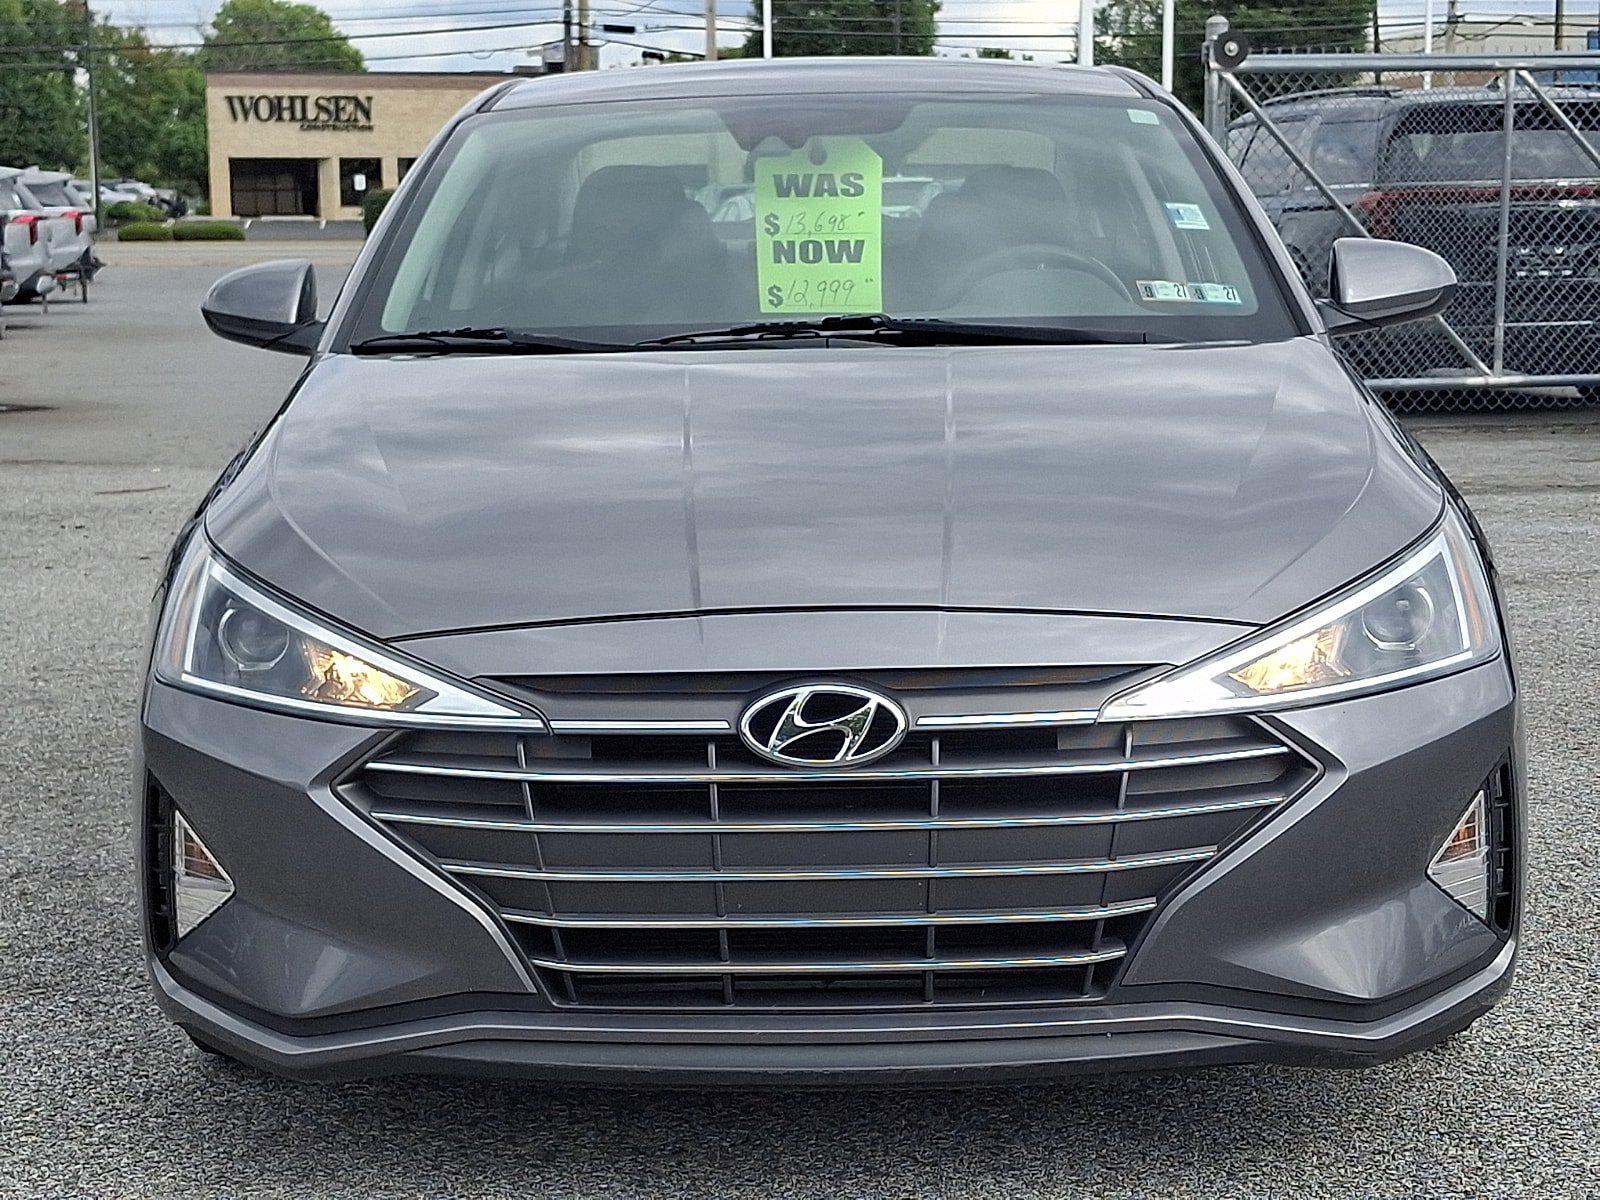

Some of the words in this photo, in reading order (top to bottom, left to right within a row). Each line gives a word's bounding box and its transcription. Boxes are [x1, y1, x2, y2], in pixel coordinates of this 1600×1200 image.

[225, 95, 373, 122] WOHLSEN
[773, 172, 865, 198] WAS
[772, 240, 865, 264] NOW
[1174, 284, 1187, 298] 27
[1223, 287, 1237, 301] 27
